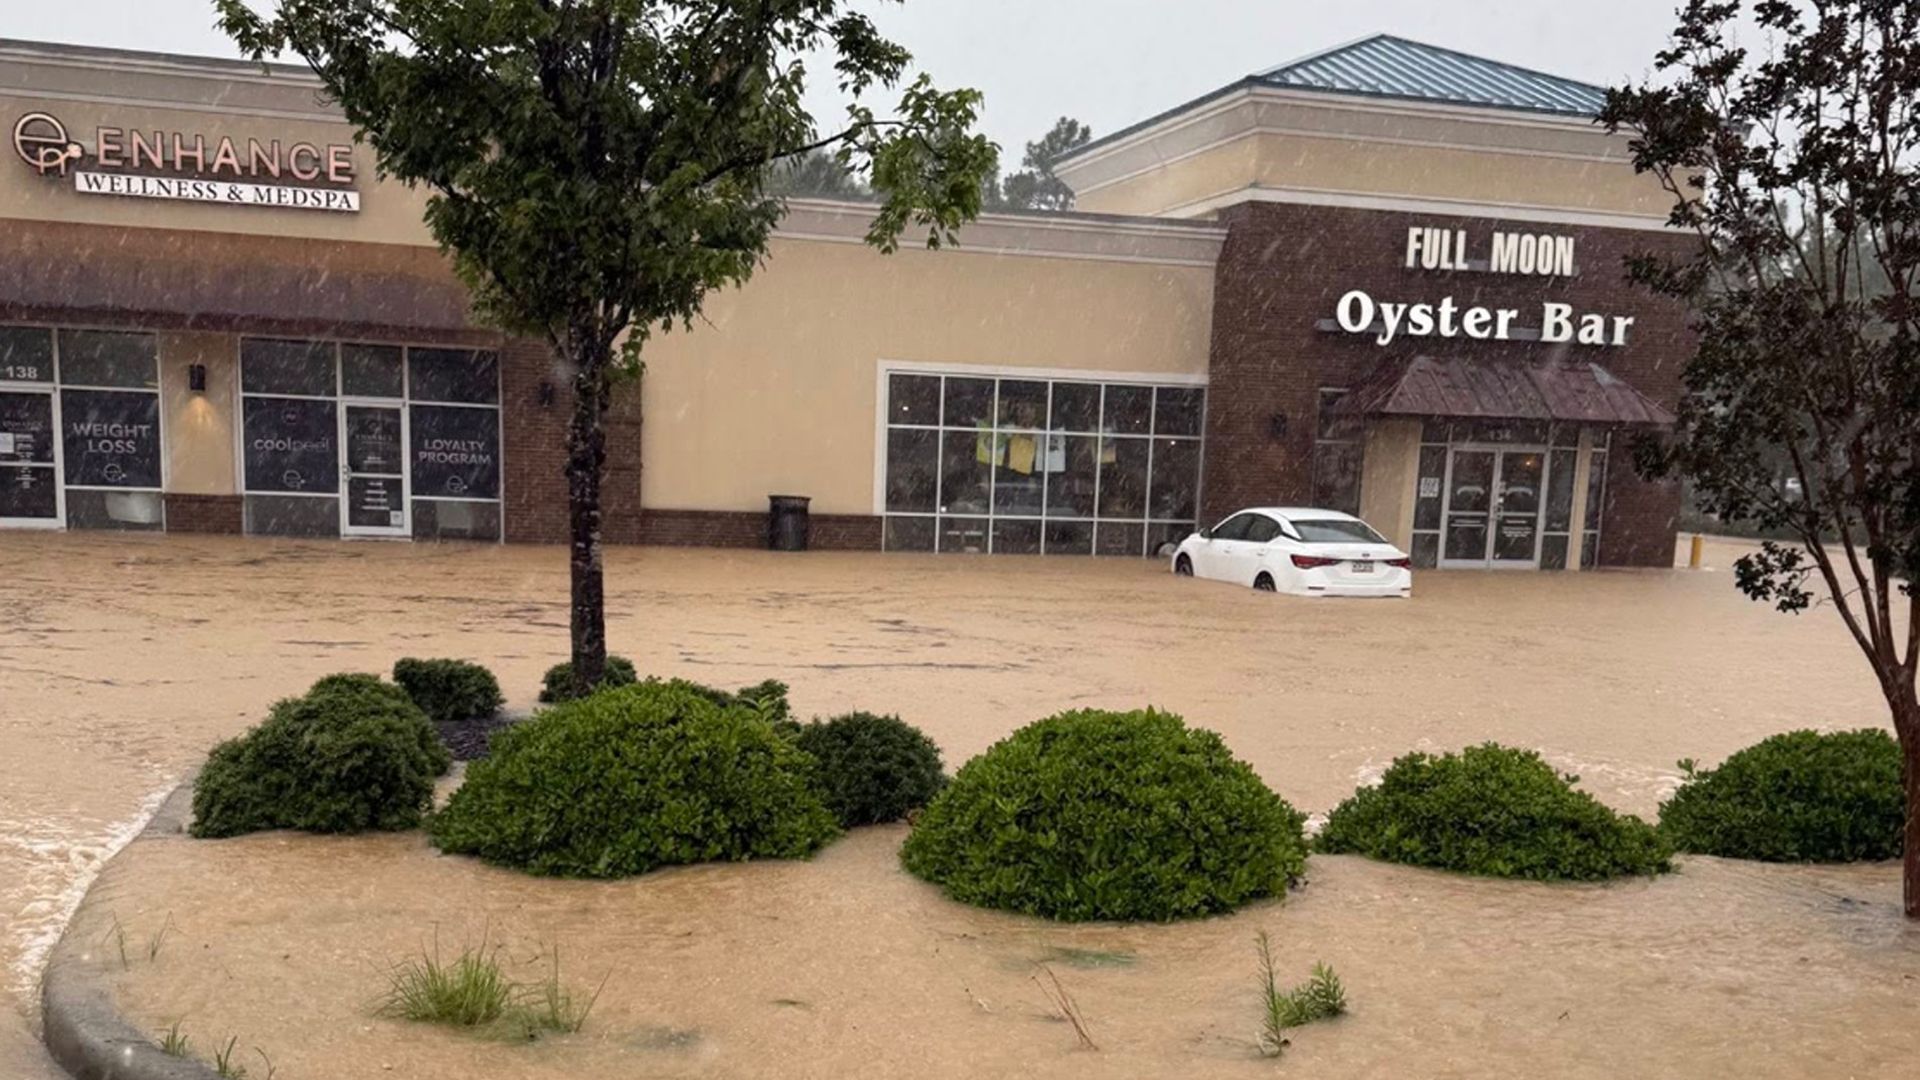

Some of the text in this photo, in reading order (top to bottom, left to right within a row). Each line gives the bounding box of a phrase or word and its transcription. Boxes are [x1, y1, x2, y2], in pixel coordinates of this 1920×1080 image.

[97, 126, 353, 183] ENHANCE
[84, 174, 353, 209] WELLNESS & MEDSPA
[1406, 227, 1574, 276] FULL MOON
[1336, 290, 1634, 346] Oyster Bar
[6, 366, 38, 380] 138
[73, 422, 150, 438] WEIGHT
[89, 439, 136, 454] LOSS
[424, 439, 486, 452] LOYALTY
[418, 452, 491, 465] PROGRAM
